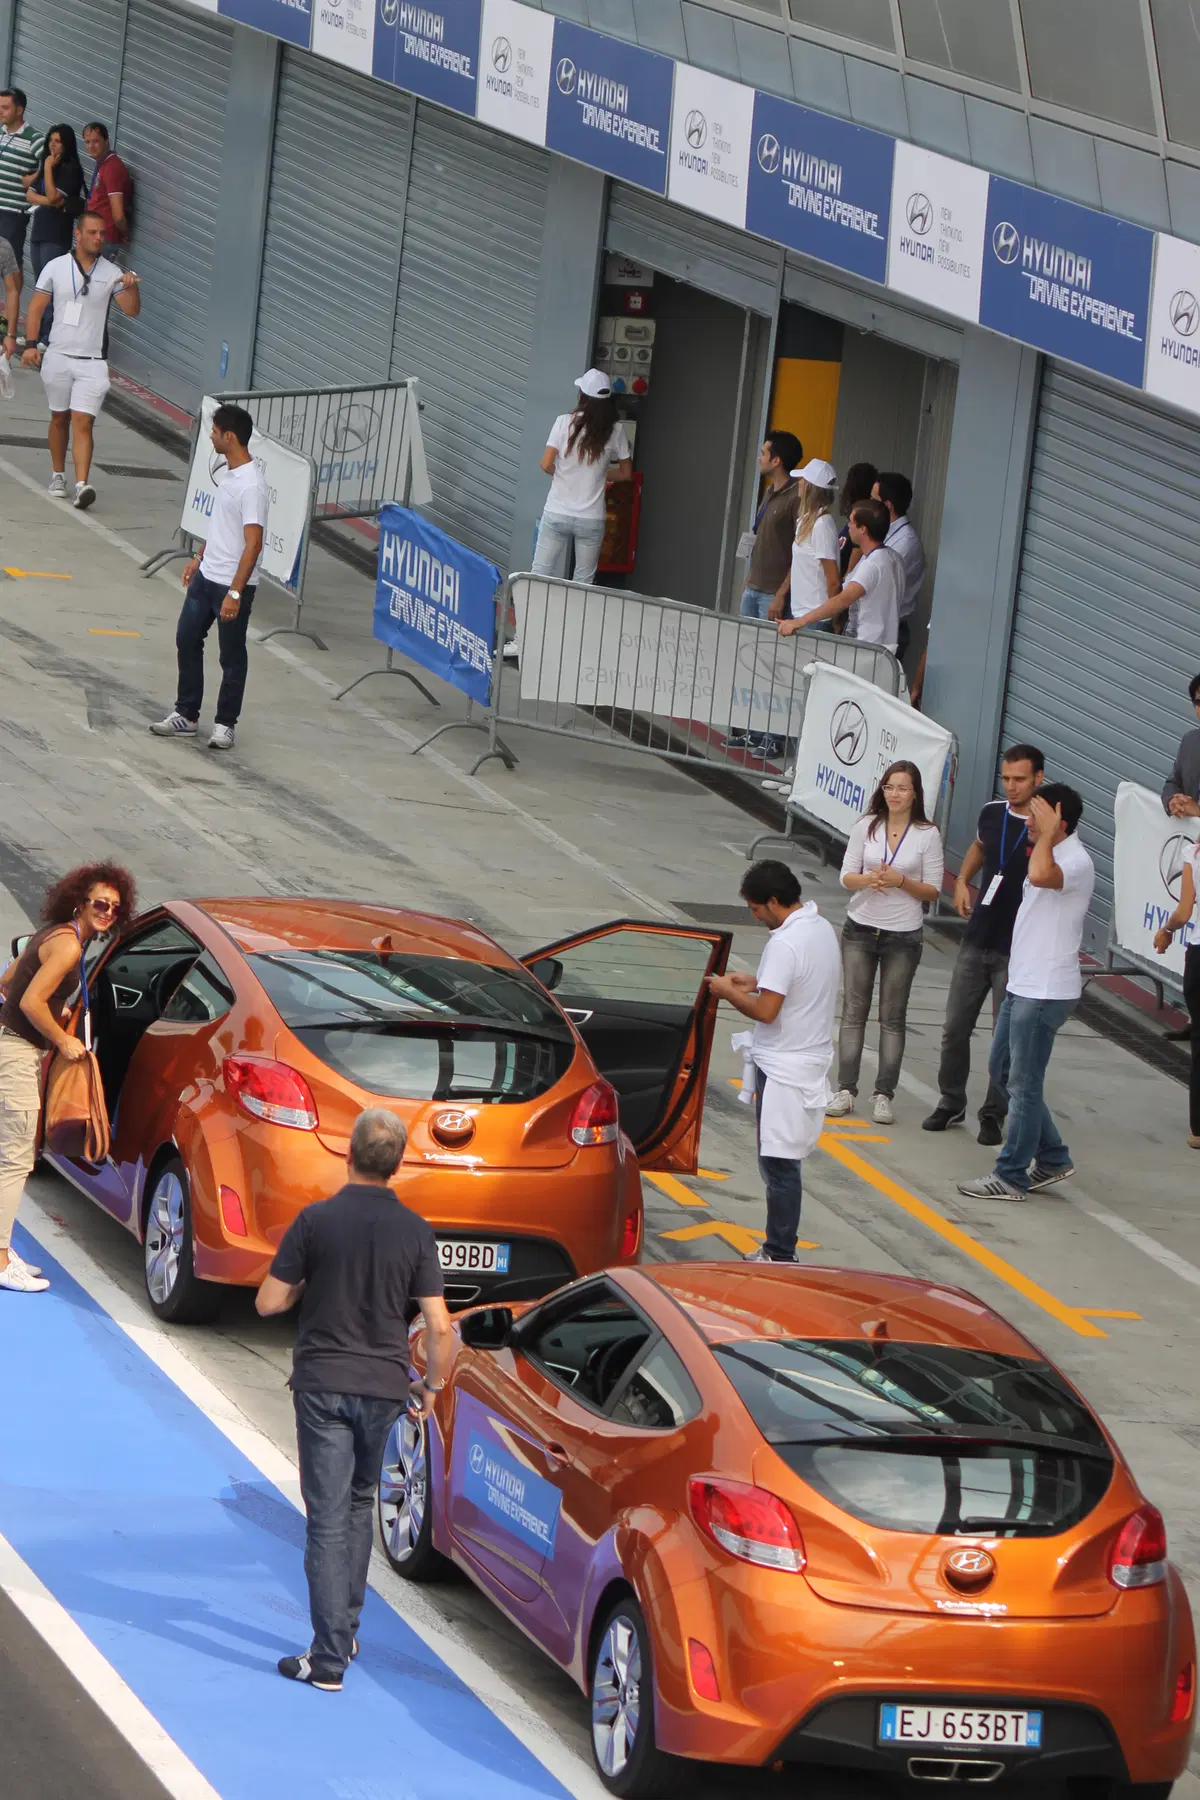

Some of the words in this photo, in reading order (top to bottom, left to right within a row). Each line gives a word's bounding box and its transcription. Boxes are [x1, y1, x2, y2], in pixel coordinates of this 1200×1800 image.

[320, 8, 345, 30] HYUNDAI
[400, 1, 445, 42] HYUNDAI
[404, 34, 429, 61] DRIVING
[430, 43, 470, 75] EXPERIENCE
[486, 74, 512, 97] HYUNDAI
[577, 68, 628, 114] HYUNDAI
[582, 103, 612, 133] DRIVING
[612, 113, 660, 151] EXPERIENCE
[679, 150, 708, 175] HYUNDAI
[782, 145, 842, 195] HYUNDAI
[788, 182, 822, 216] DRIVING
[823, 195, 879, 236] EXPERIENCE
[900, 235, 935, 264] HYUNDAI
[1022, 234, 1092, 291] HYUNDAI
[1029, 276, 1070, 312] DRIVING
[1070, 291, 1135, 336] EXPERIENCE
[381, 530, 460, 615] HYUNDAI
[389, 587, 436, 640] DRIVING
[816, 763, 865, 813] HYUNDAI
[441, 1244, 494, 1269] 99BD
[484, 1457, 525, 1504] HYUNDAI
[487, 1486, 511, 1516] DRIVING
[510, 1500, 549, 1538] EXPERIENCE
